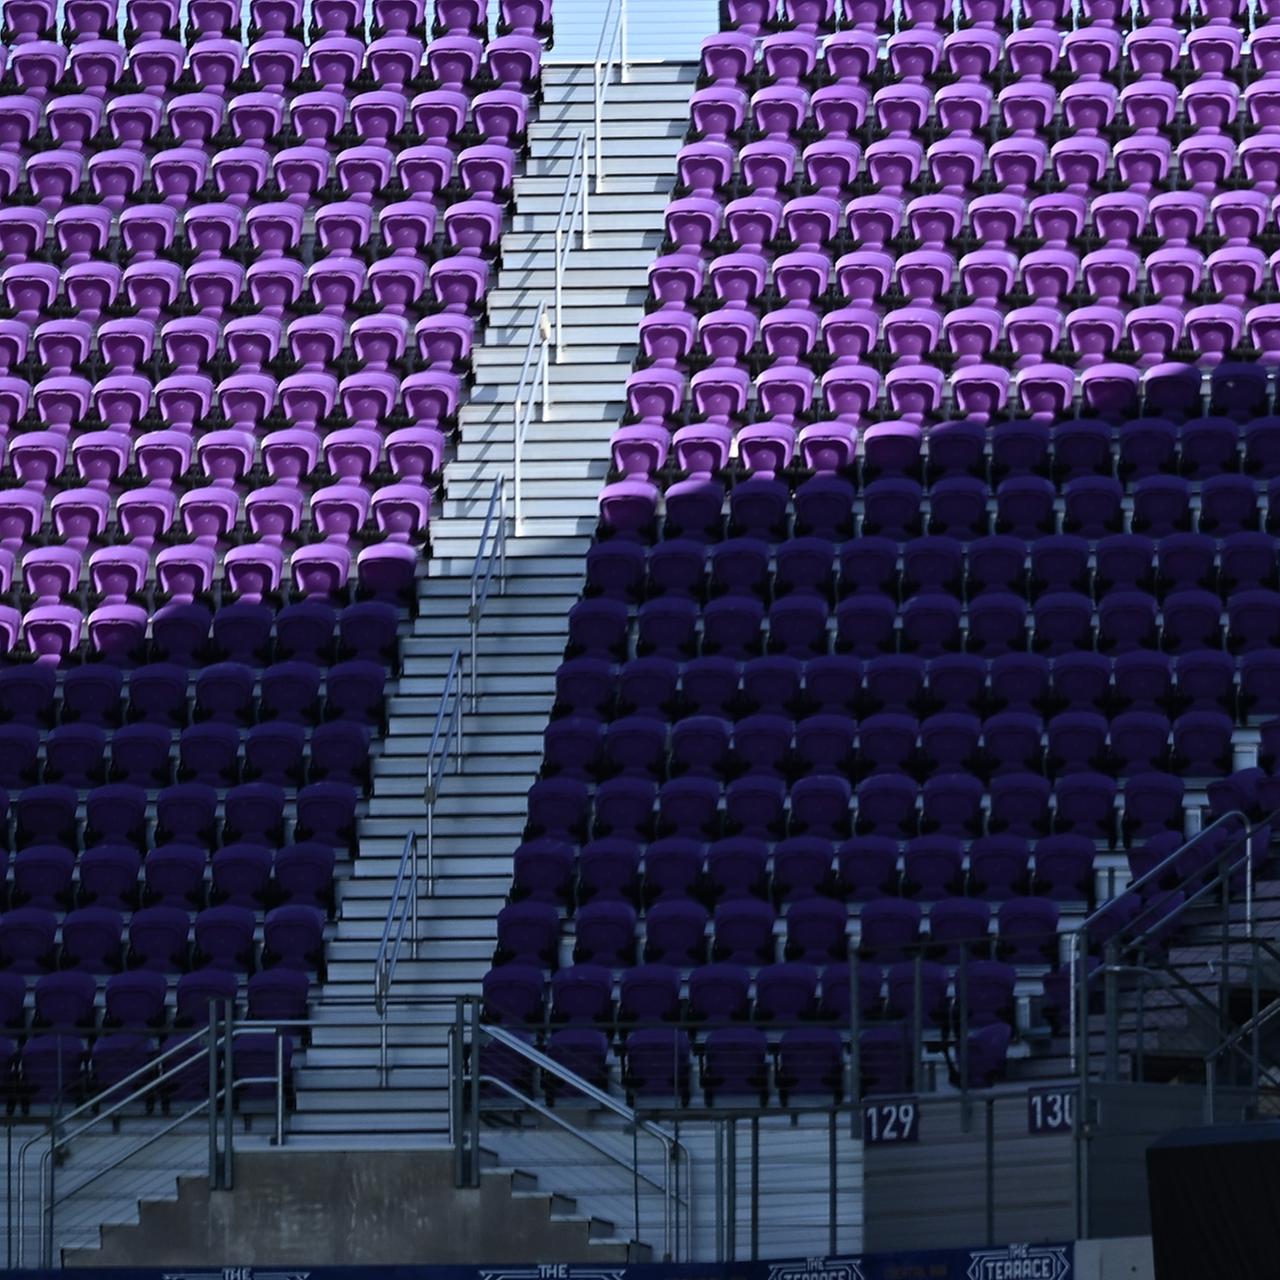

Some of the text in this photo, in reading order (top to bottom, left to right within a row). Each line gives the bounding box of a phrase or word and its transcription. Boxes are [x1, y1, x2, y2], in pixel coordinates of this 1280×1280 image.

[867, 1103, 915, 1140] 129
[1009, 1243, 1029, 1258] THE
[537, 1264, 568, 1279] THE
[806, 1257, 826, 1271] THE
[984, 1258, 1050, 1280] TERRACE
